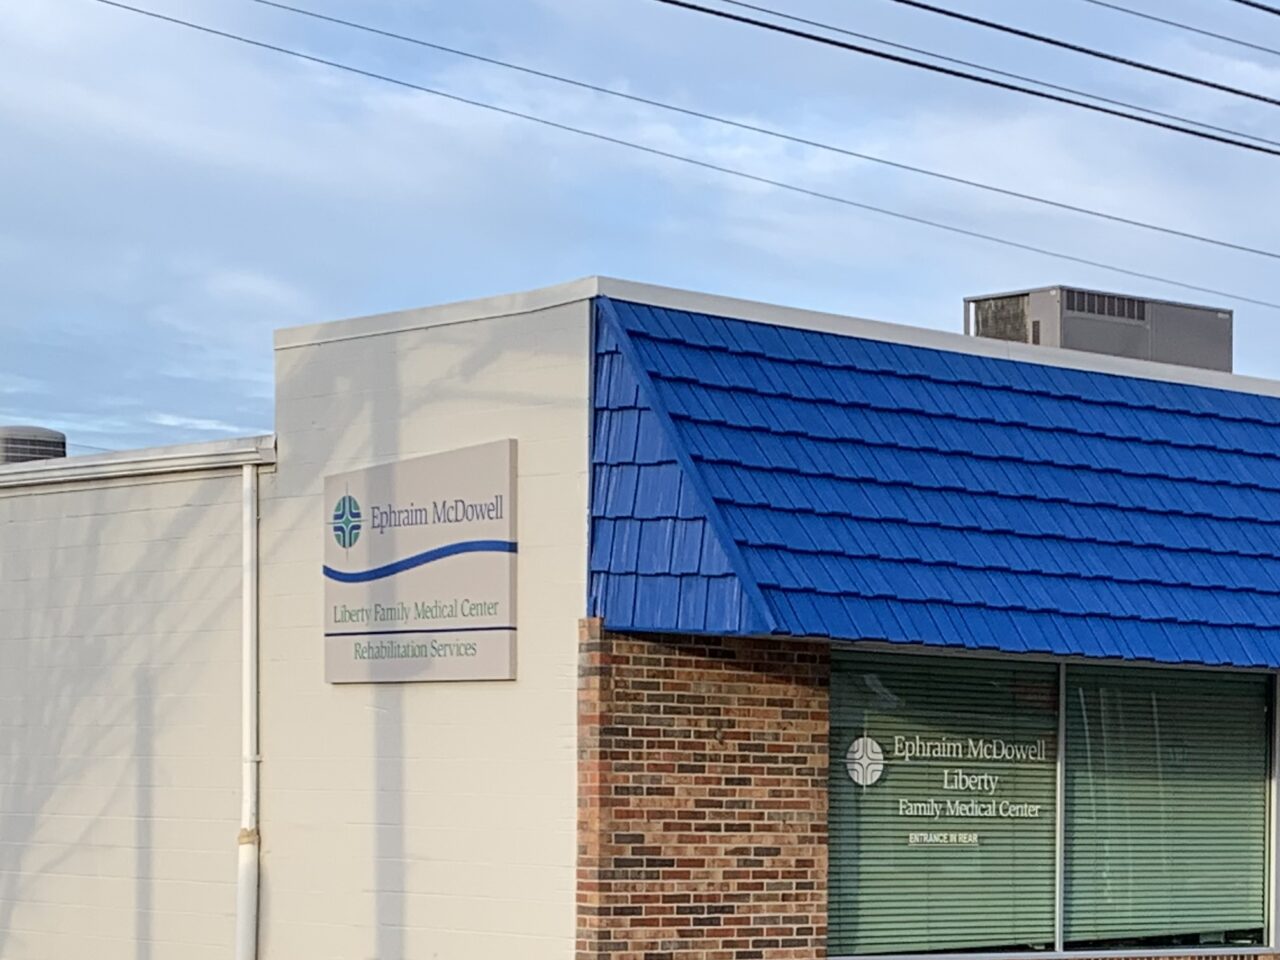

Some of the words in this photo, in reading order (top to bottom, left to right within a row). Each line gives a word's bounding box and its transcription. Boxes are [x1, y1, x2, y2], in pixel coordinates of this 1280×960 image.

[371, 502, 428, 534] Ephraim
[432, 495, 504, 524] McDowell
[333, 604, 372, 626] Liberty
[374, 602, 411, 624] Family
[414, 599, 458, 620] Medical
[461, 598, 499, 617] Center
[354, 640, 428, 660] Rehabilitation
[430, 639, 477, 658] Services
[894, 735, 963, 761] Ephraim
[967, 738, 1046, 761] McDowell
[943, 769, 999, 795] Liberty
[898, 798, 942, 820] Family
[945, 799, 997, 817] Medical
[1000, 800, 1041, 818] Center
[908, 833, 949, 844] ENTRANCE
[949, 833, 957, 844] IN
[958, 833, 979, 844] REAR
